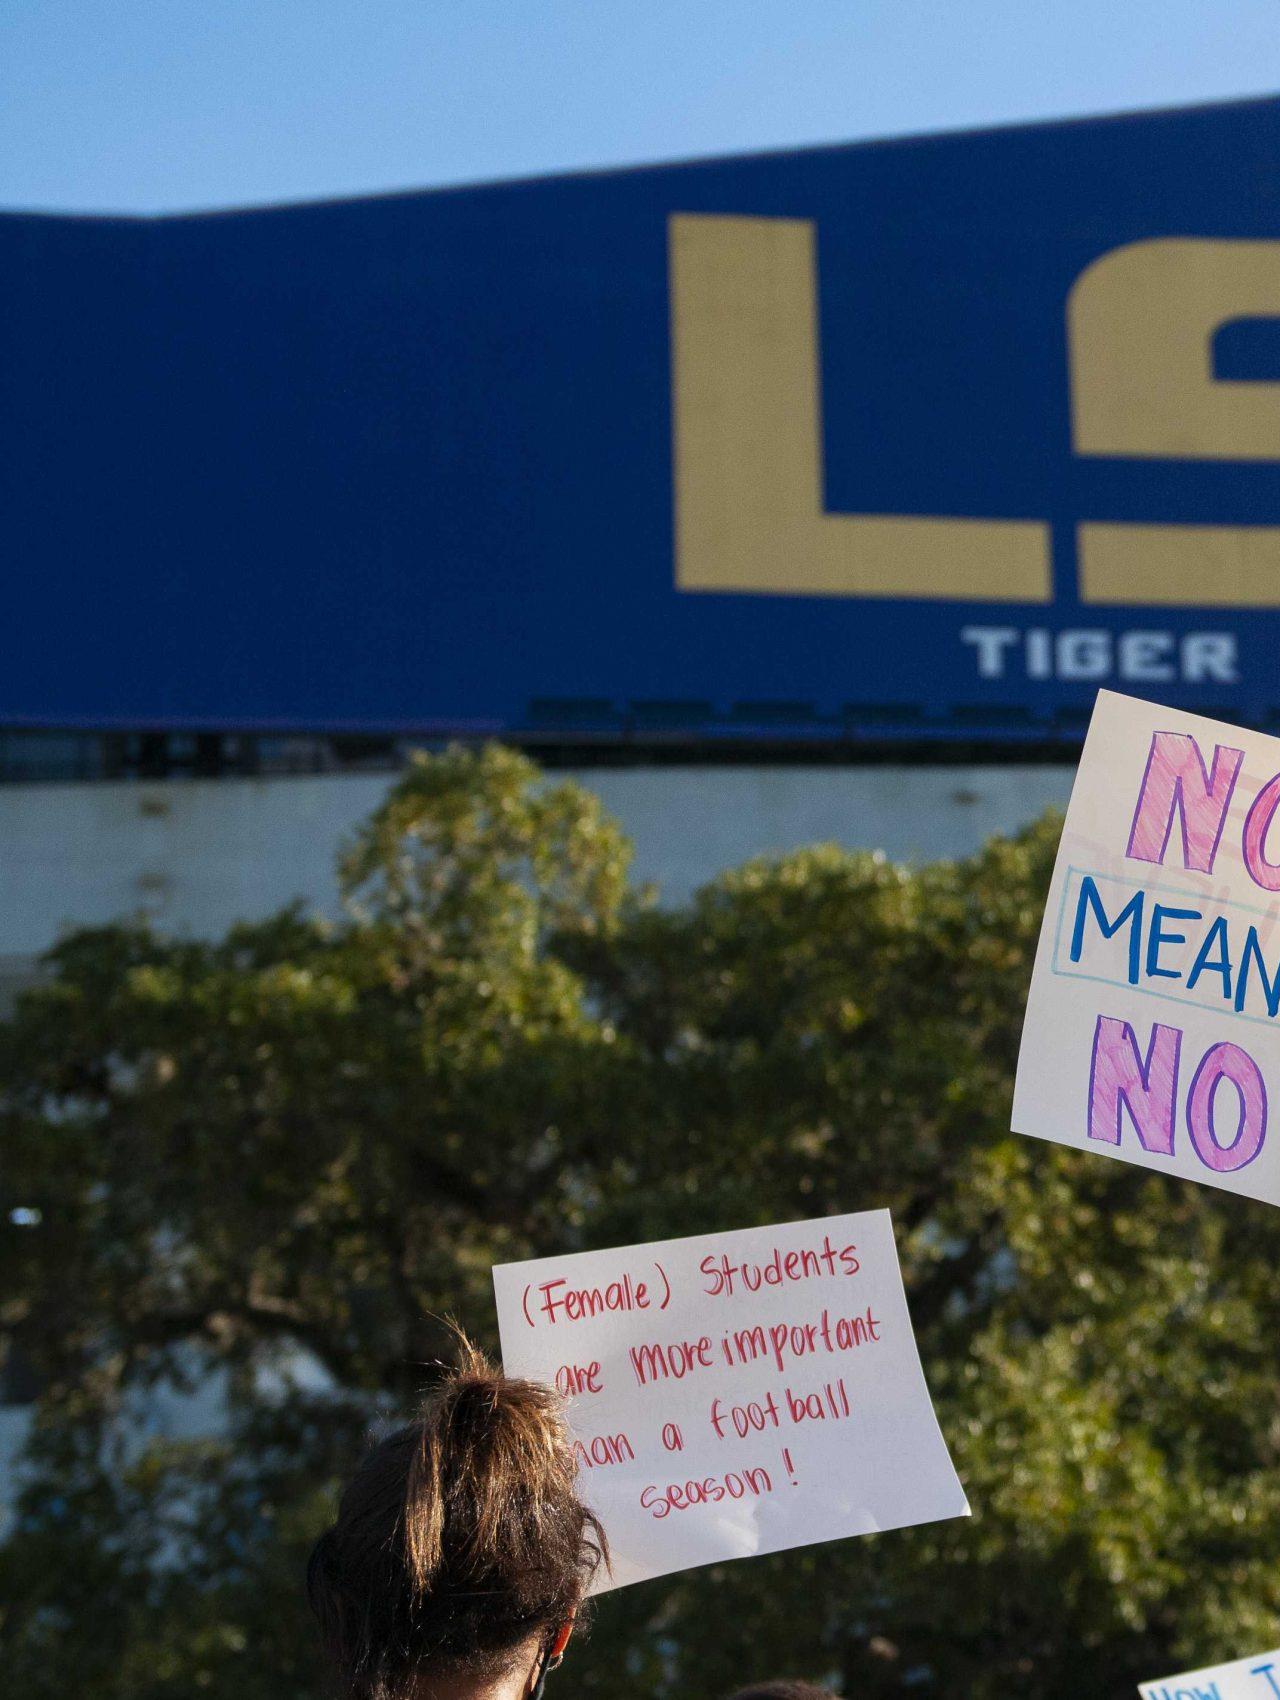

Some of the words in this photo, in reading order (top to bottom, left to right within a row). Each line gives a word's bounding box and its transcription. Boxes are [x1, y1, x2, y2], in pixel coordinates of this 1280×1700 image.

[962, 625, 1239, 684] TIGER
[1086, 1013, 1268, 1173] NO
[522, 1262, 671, 1328] (Female)
[555, 1359, 603, 1400] are
[722, 1306, 882, 1373] important
[572, 1432, 636, 1470] an
[661, 1422, 683, 1452] a
